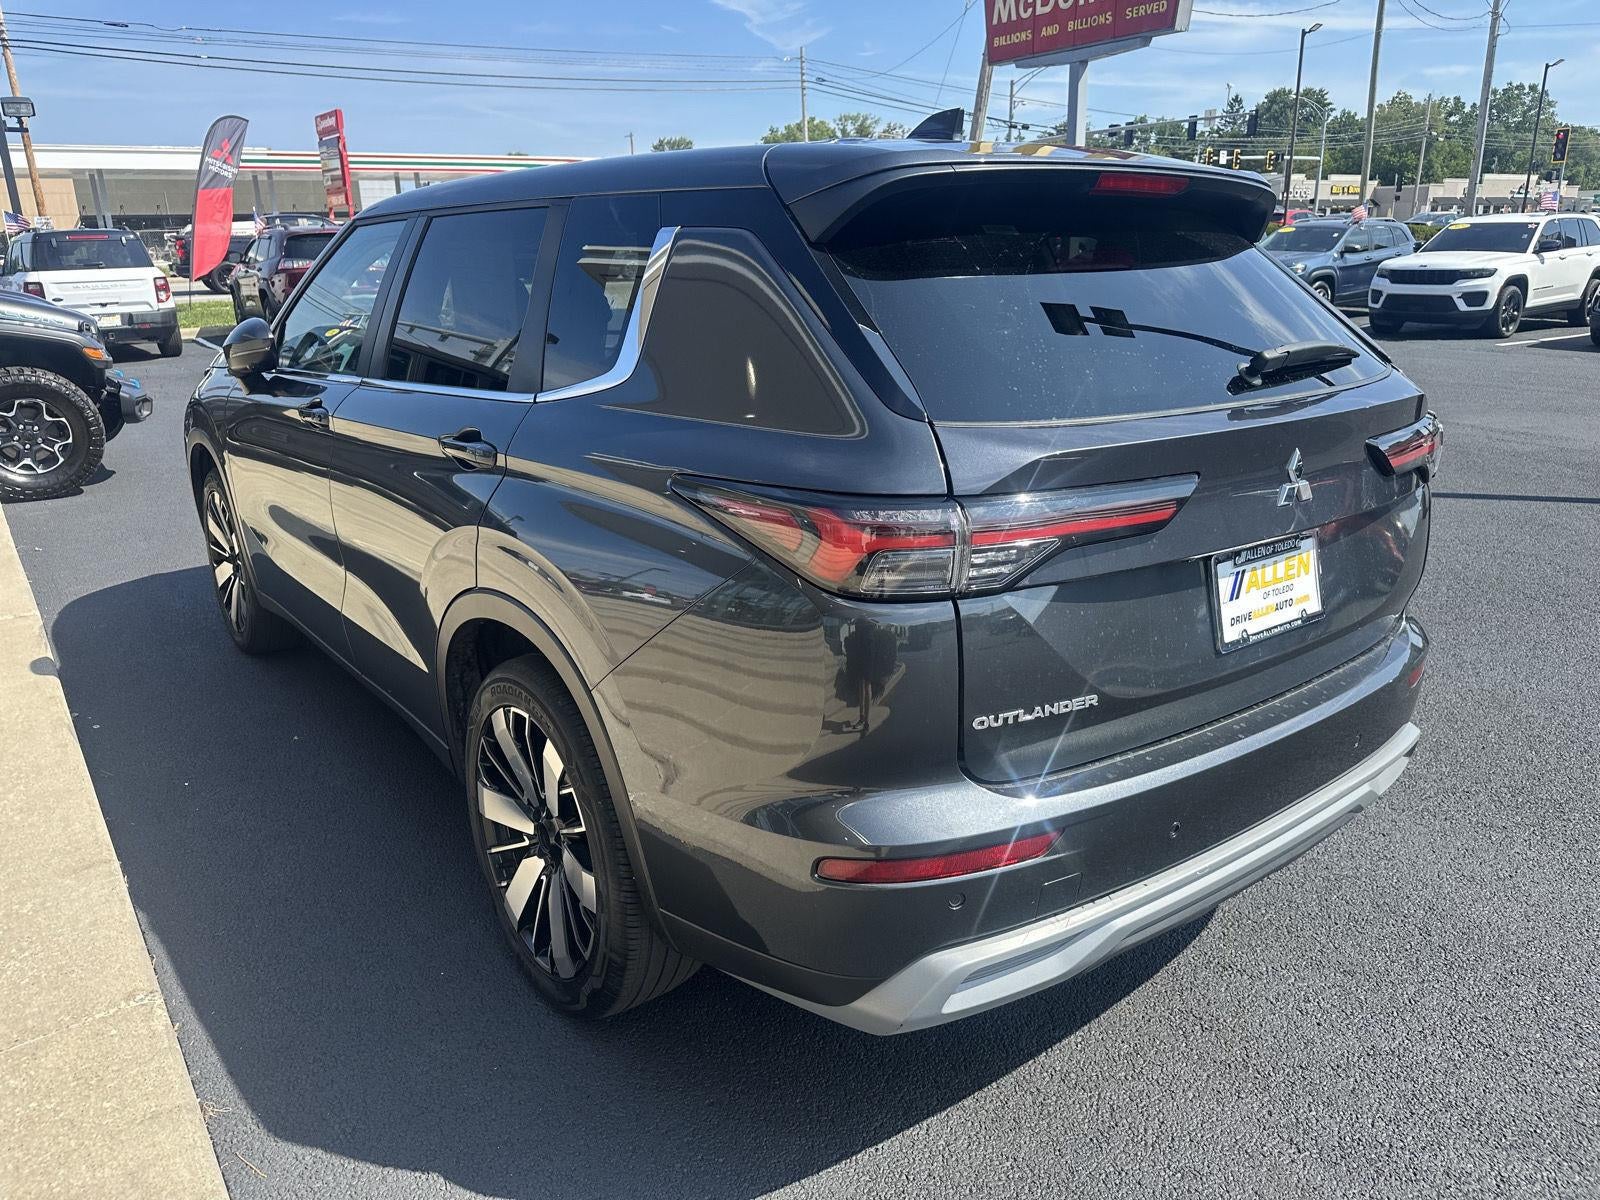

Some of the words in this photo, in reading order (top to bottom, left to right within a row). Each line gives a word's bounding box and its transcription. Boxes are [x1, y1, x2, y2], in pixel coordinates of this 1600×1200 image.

[993, 30, 1033, 47] BILLIONS
[1040, 23, 1060, 37] AND
[1067, 12, 1113, 32] BILLIONS
[1125, 0, 1168, 19] SERVED
[209, 165, 233, 179] MOTORS
[1246, 546, 1266, 561] ALLEN
[1266, 545, 1274, 555] OF
[1274, 539, 1296, 552] TOLEDO
[1245, 550, 1311, 593] ALLEN
[1262, 590, 1271, 600] OF
[1271, 583, 1295, 597] TOLEDO
[972, 694, 1099, 730] OUTLANDER
